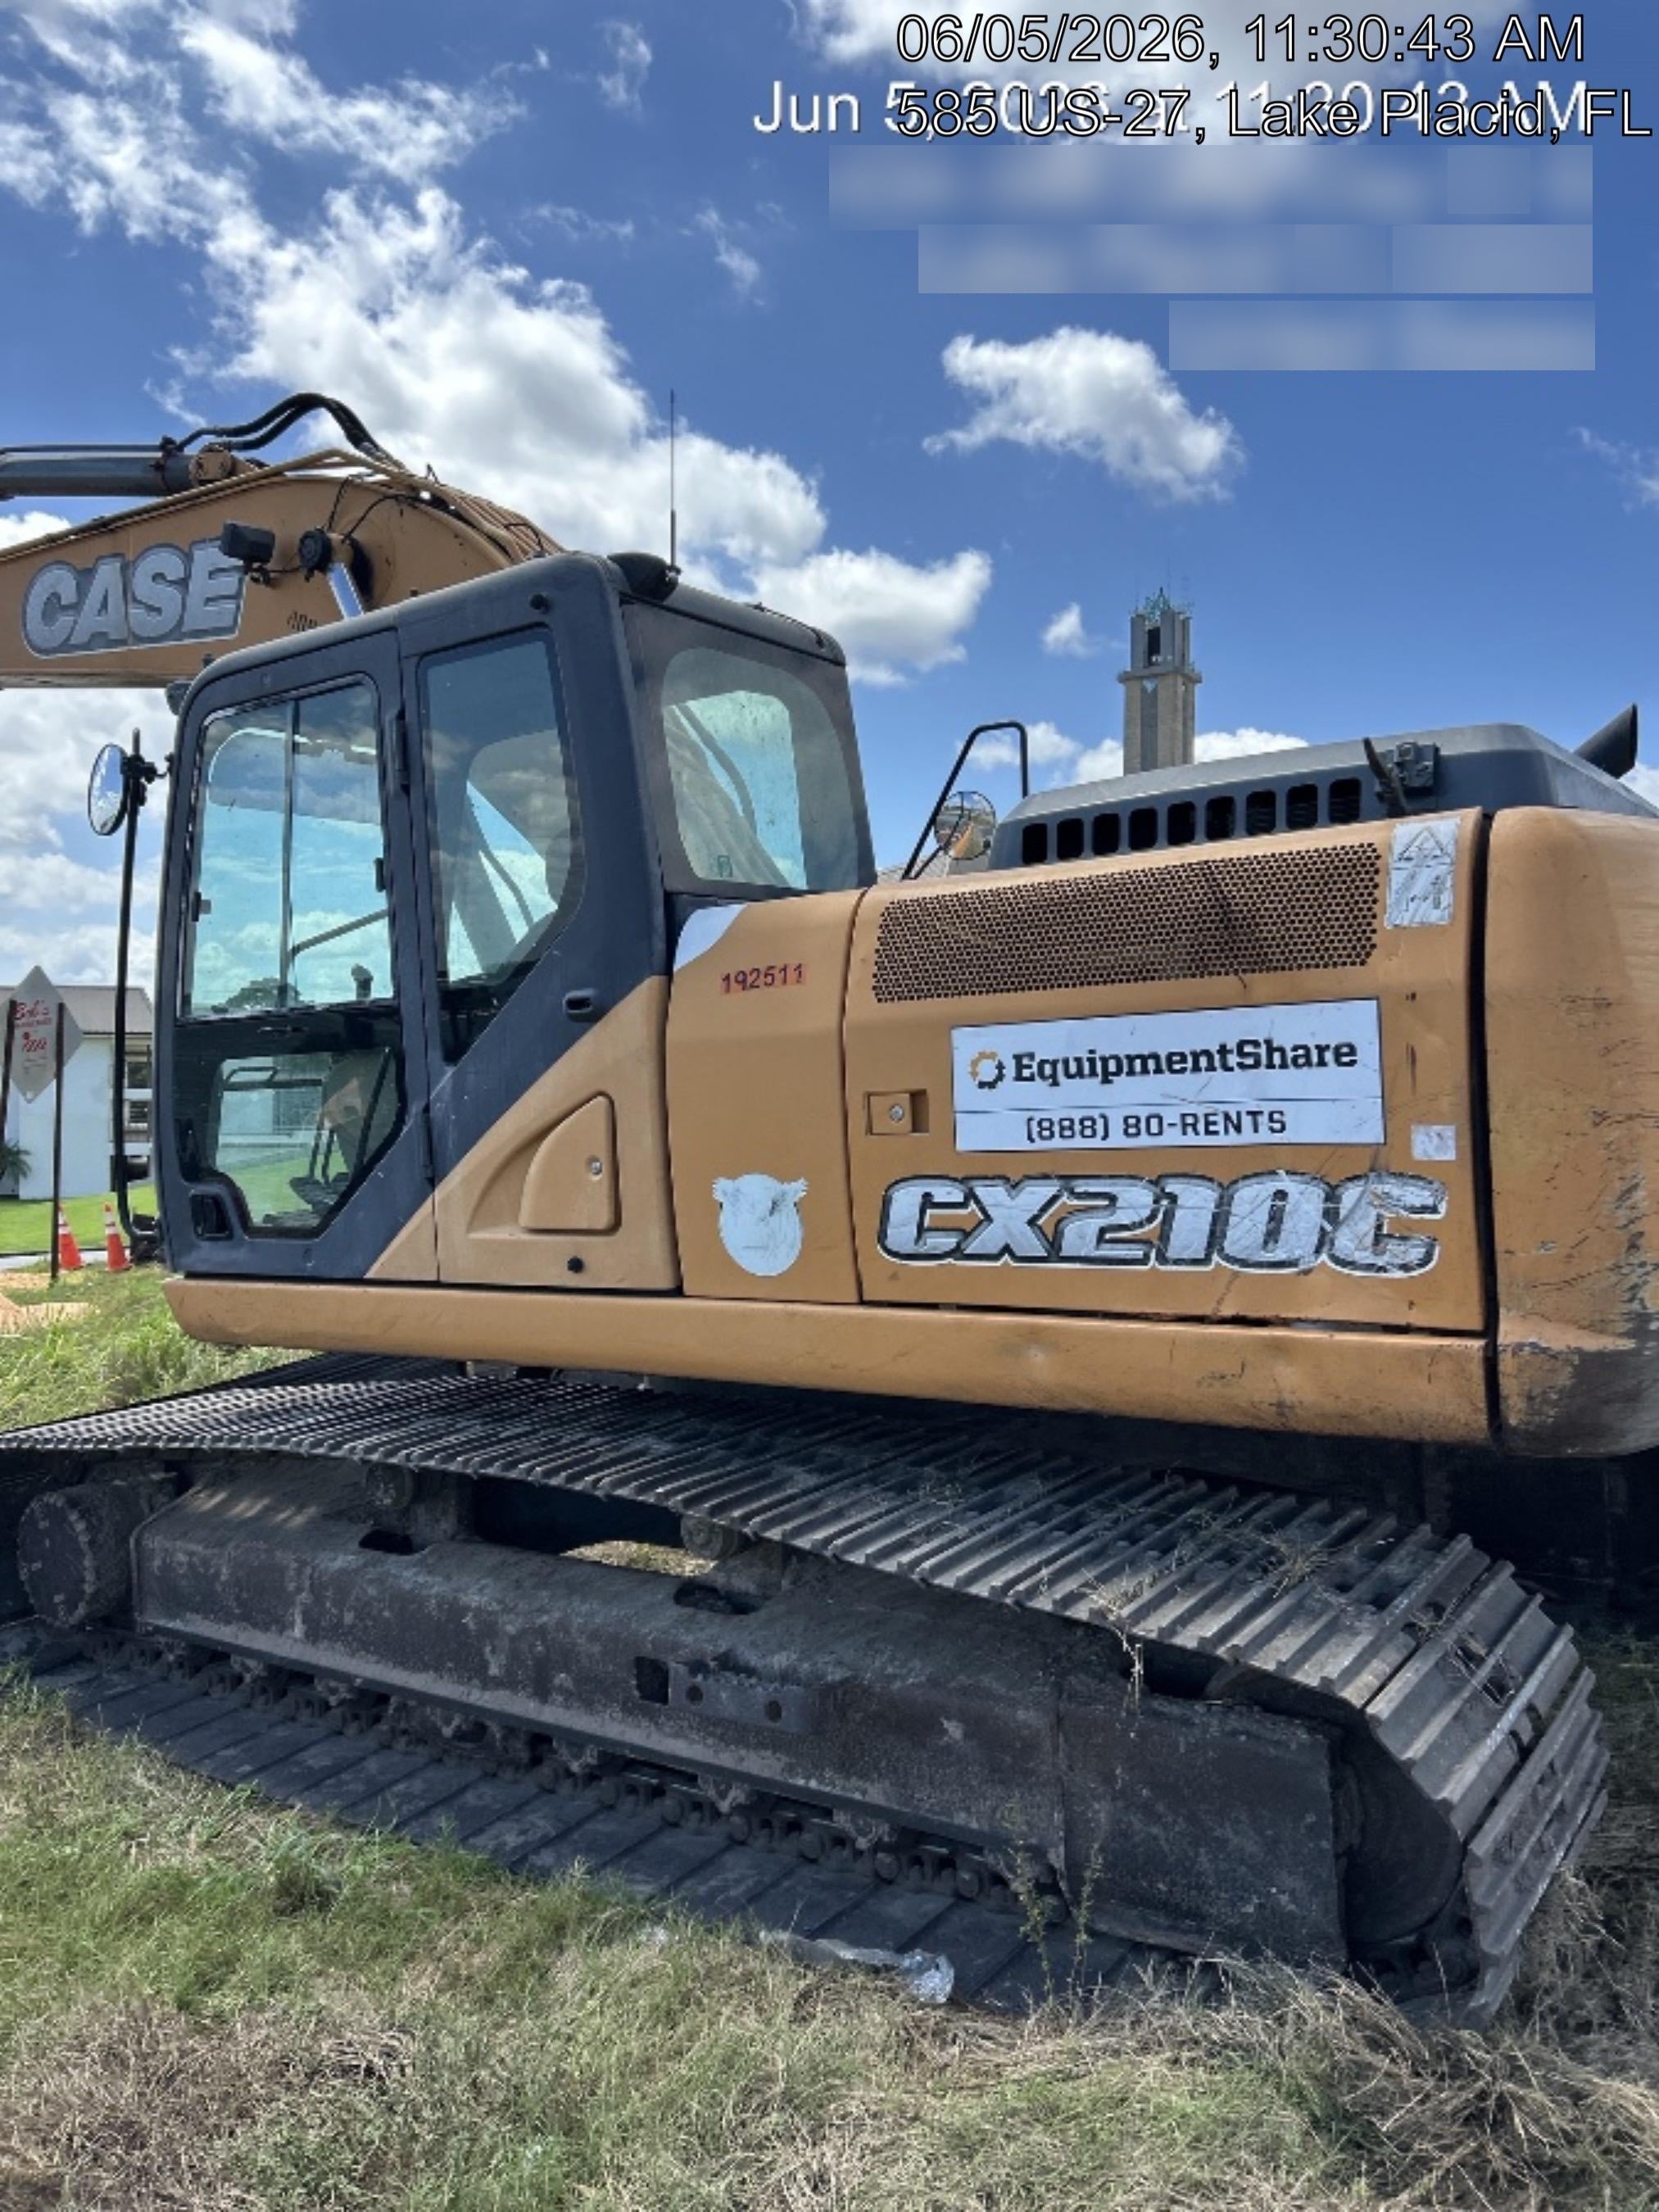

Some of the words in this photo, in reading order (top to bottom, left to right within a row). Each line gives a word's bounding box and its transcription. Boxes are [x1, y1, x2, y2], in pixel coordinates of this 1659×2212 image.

[25, 538, 245, 658] CASE
[721, 963, 804, 994] 192511
[1012, 1038, 1358, 1087] EquipmentShare
[1026, 1113, 1110, 1143] (888)
[1122, 1110, 1287, 1137] 80-RENTS
[877, 1171, 1449, 1278] CX210C
